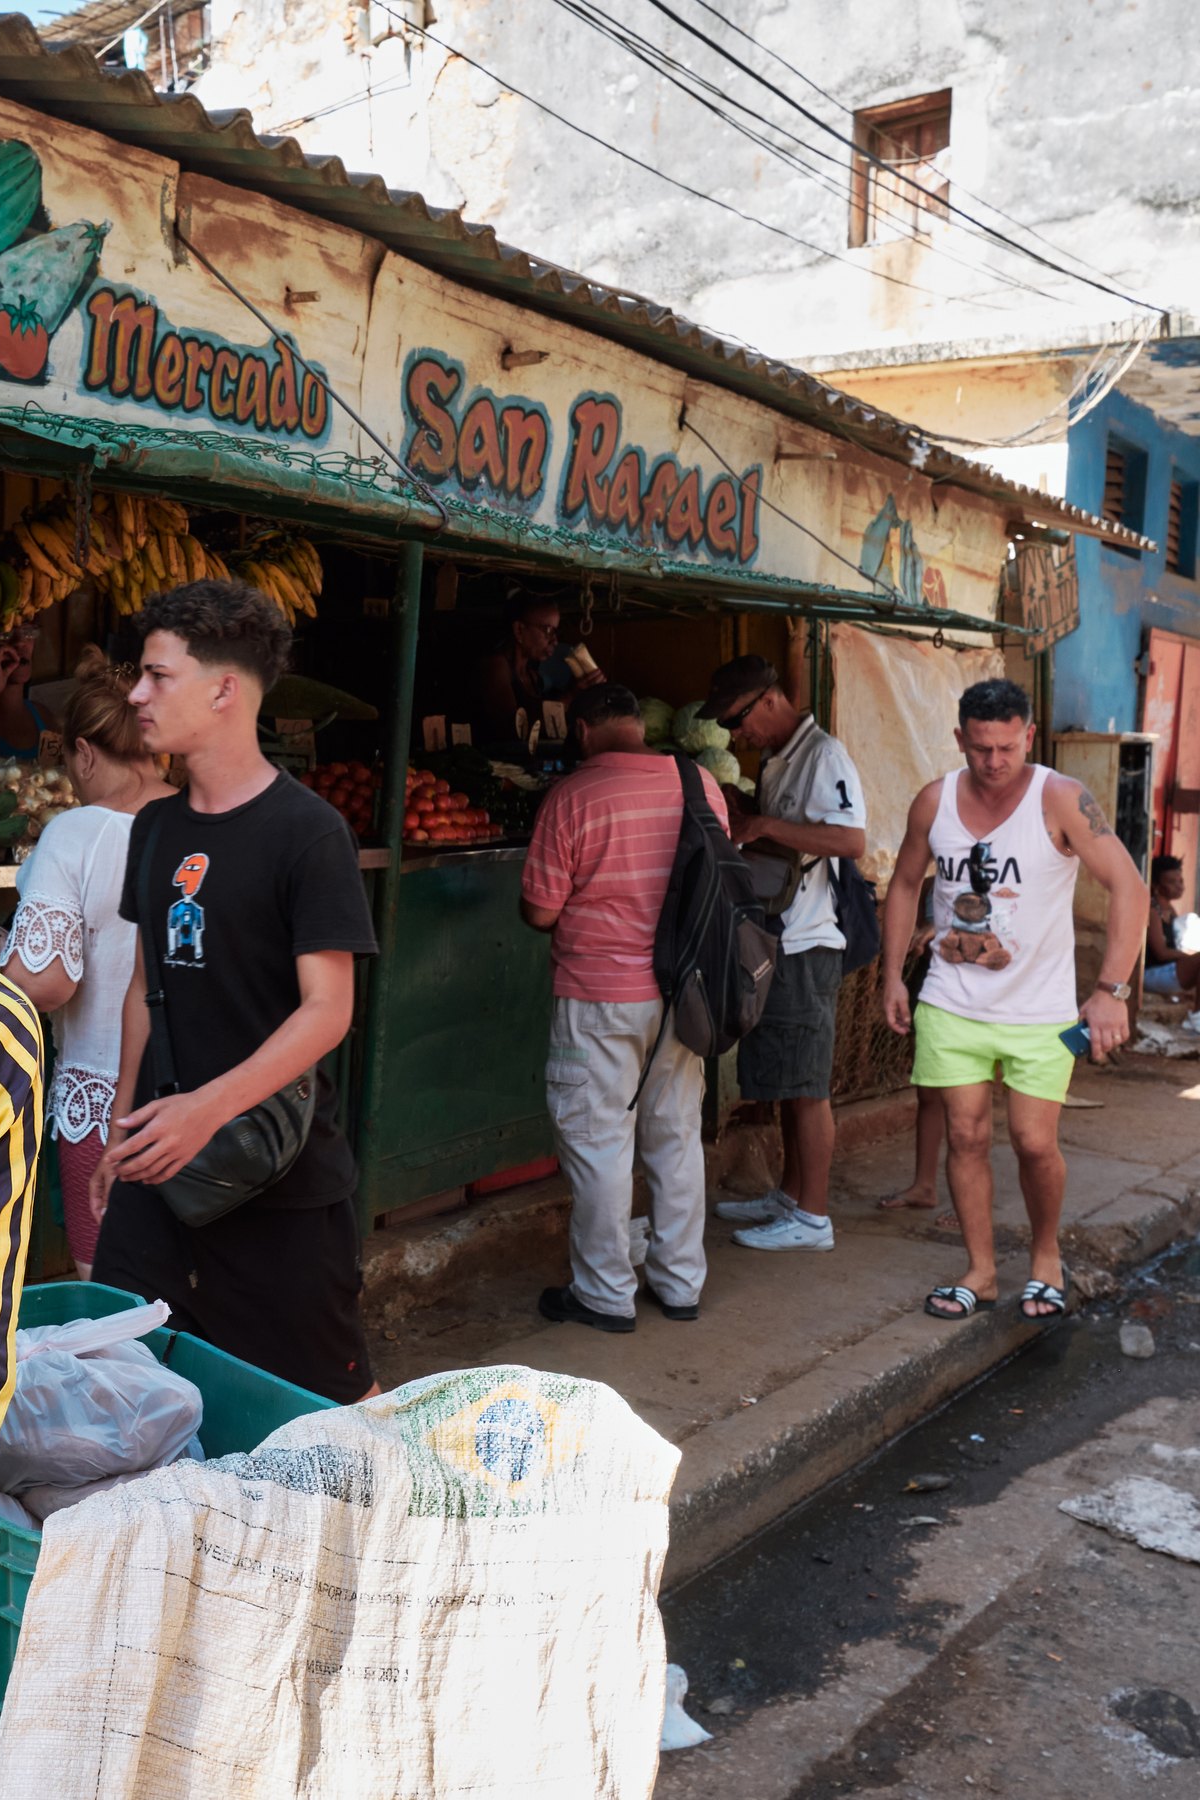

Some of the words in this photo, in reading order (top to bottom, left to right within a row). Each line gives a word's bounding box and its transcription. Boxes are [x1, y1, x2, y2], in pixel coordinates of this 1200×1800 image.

[85, 288, 329, 438] Mercado
[406, 356, 548, 499] San
[566, 394, 761, 564] Rafael
[836, 780, 852, 809] 1
